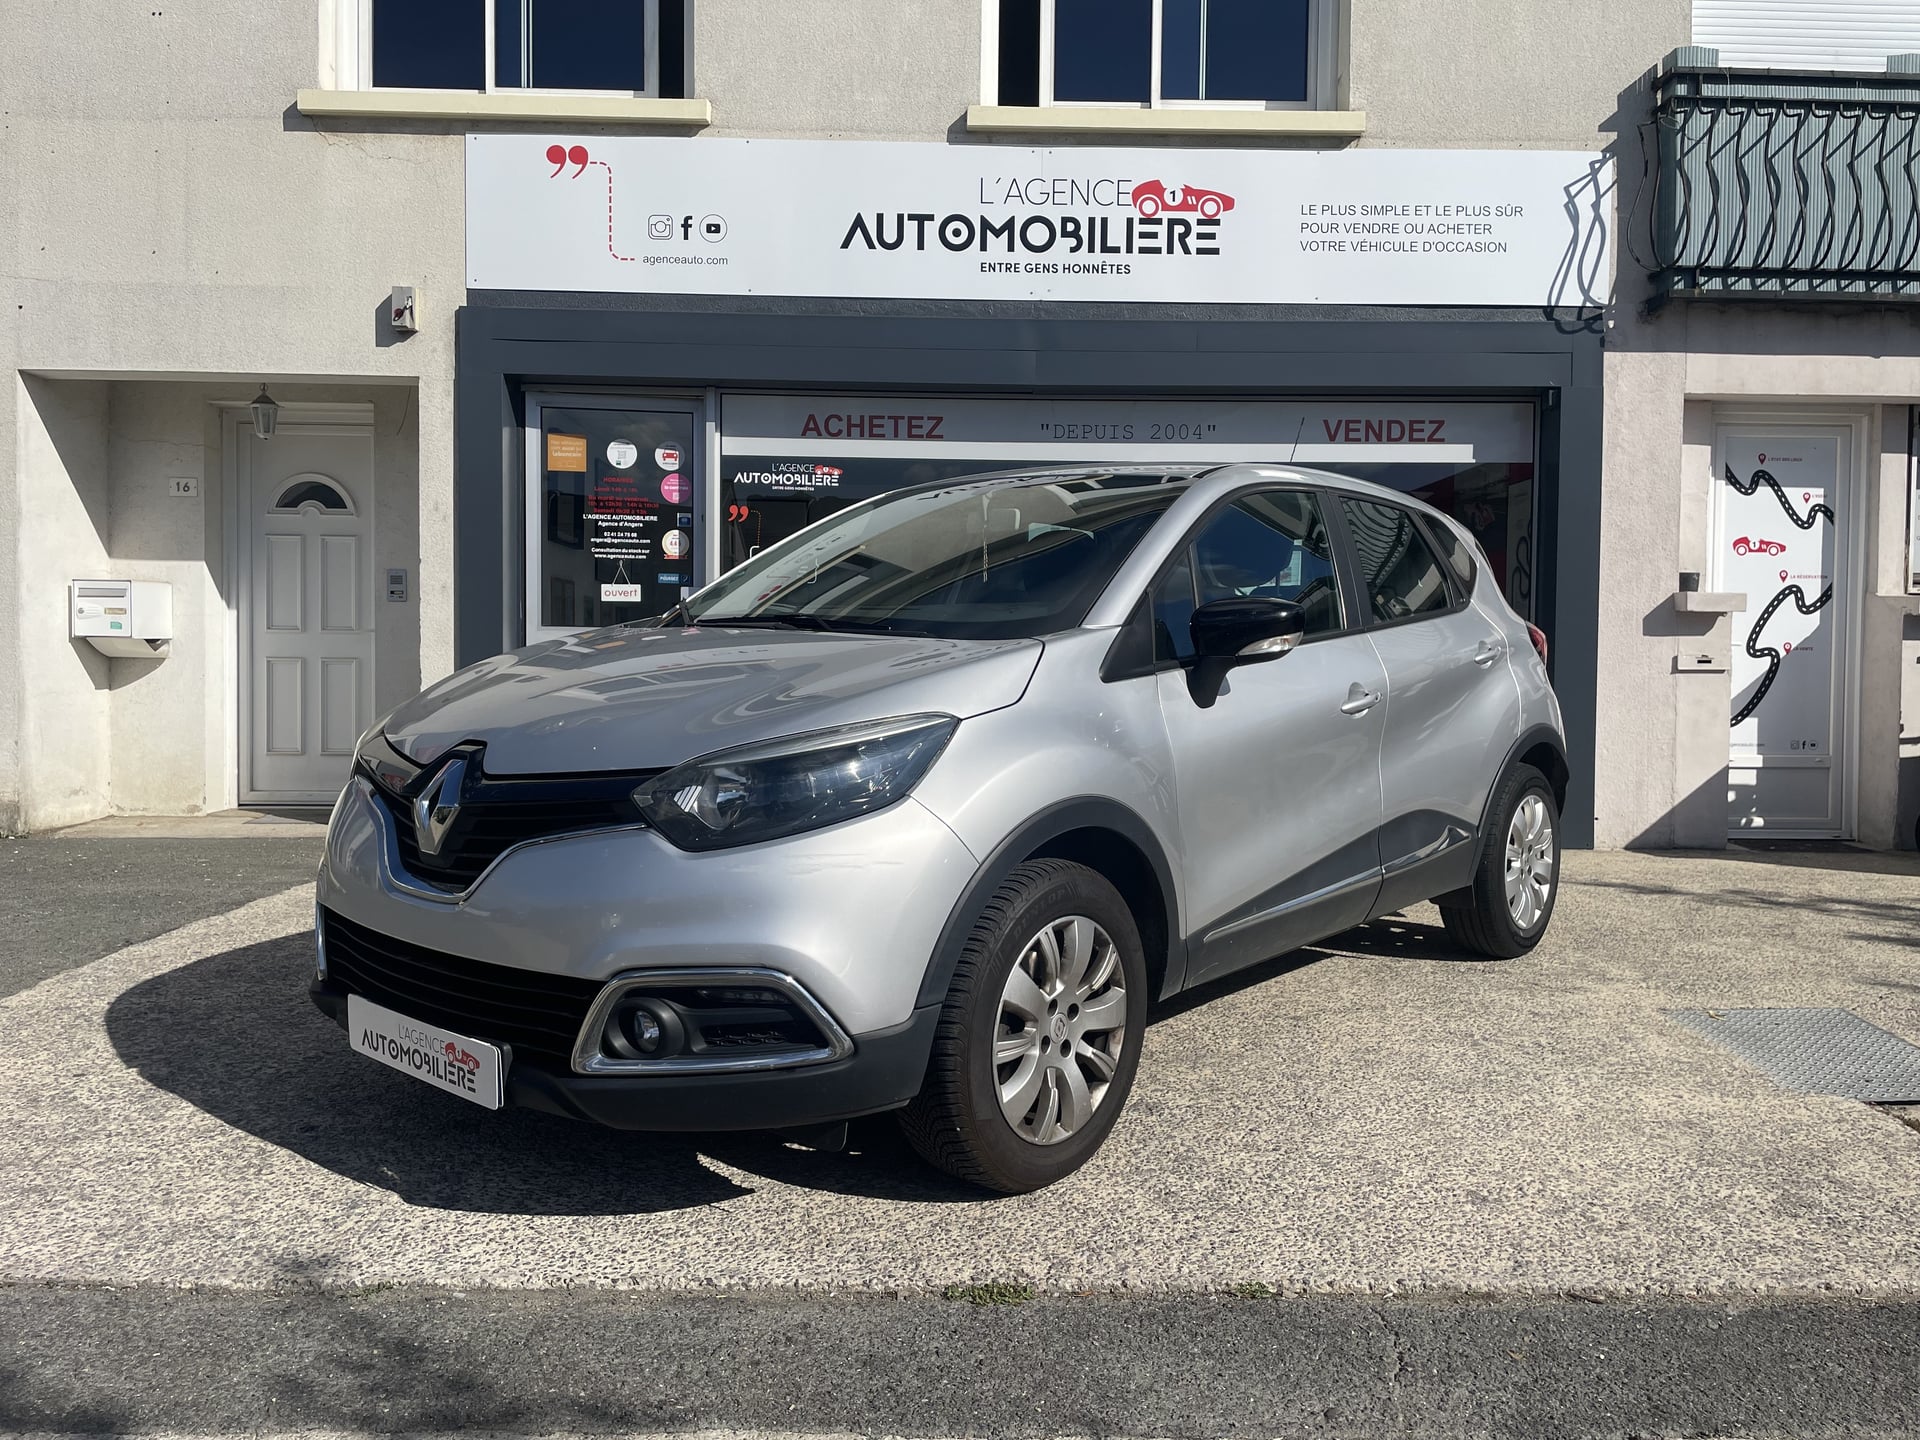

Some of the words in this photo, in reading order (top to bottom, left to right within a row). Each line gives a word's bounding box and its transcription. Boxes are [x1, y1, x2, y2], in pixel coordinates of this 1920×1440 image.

[980, 177, 1132, 206] L'AGENCE
[1300, 204, 1317, 216] LE
[1321, 204, 1357, 216] PLUS
[1360, 205, 1410, 216] SIMPLE
[1414, 205, 1432, 216] ET
[1435, 205, 1451, 216] LE
[1455, 205, 1491, 217] PLUS
[1495, 203, 1524, 217] SÛR
[1300, 222, 1339, 234] POUR
[1343, 223, 1399, 234] VENDRE
[1404, 223, 1424, 234] OU
[1427, 223, 1492, 235] ACHETER
[1300, 240, 1347, 252] VOTRE
[1350, 238, 1419, 253] VÉHICULE
[1422, 241, 1507, 253] D'OCCASION
[642, 255, 728, 266] agenceauto.com
[980, 262, 1021, 273] ENTRE
[1024, 263, 1059, 274] GENS
[1062, 260, 1131, 275] HONNÊTES
[801, 413, 944, 439] ACHETEZ
[1040, 423, 1134, 440] "DEPUIS
[1150, 423, 1217, 440] 2004"
[1323, 419, 1446, 443] VENDEZ
[772, 463, 815, 473] L'AGENCE
[176, 481, 190, 492] 16
[604, 589, 637, 597] ouvert
[398, 1023, 446, 1057] L'AGENCE
